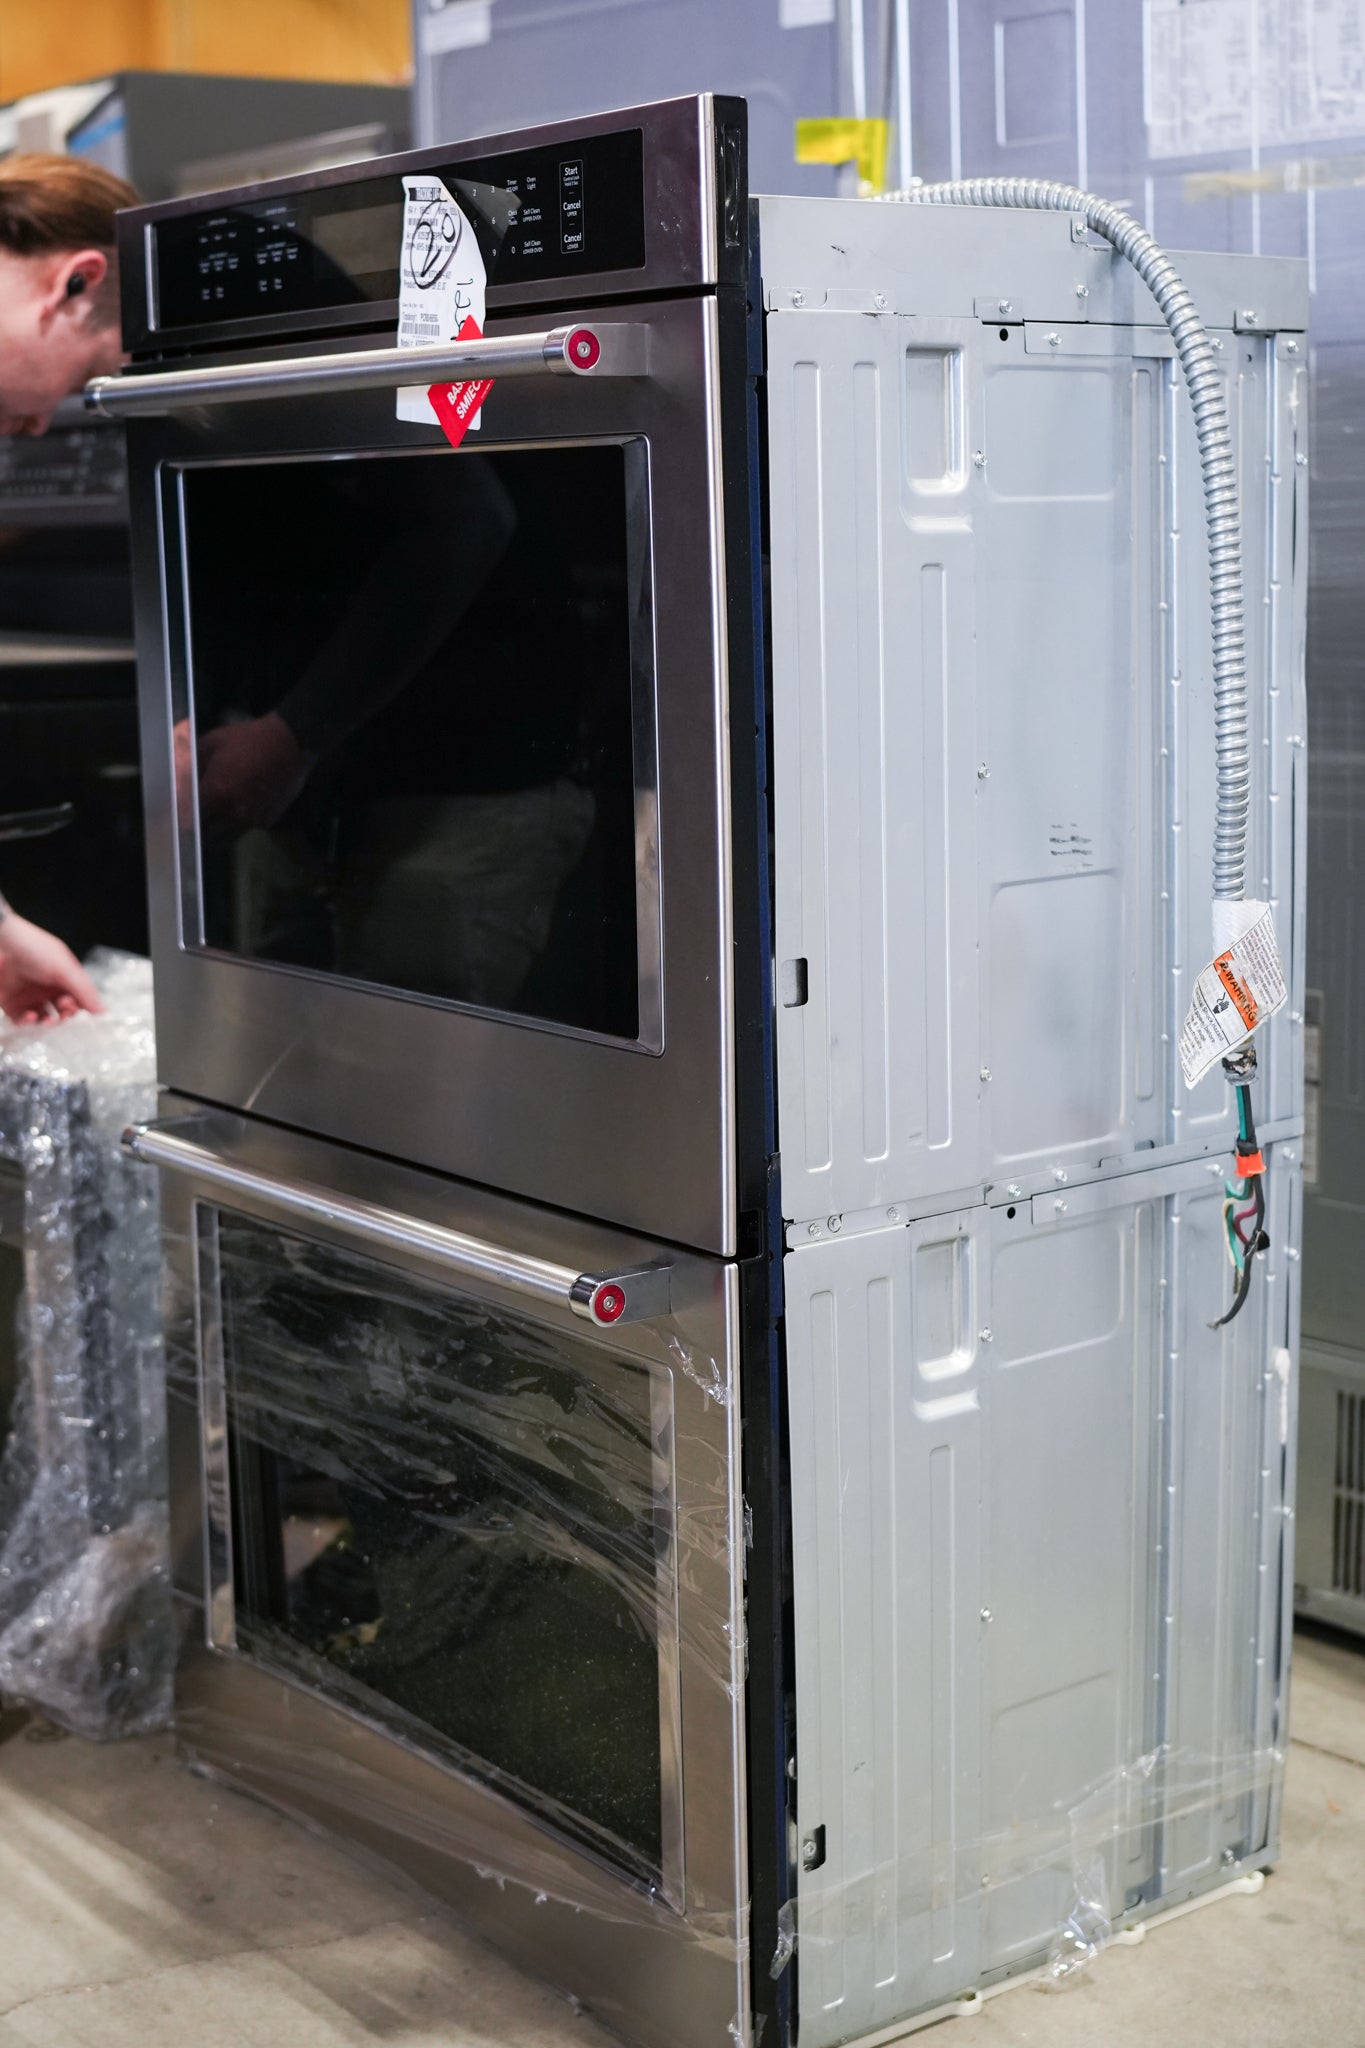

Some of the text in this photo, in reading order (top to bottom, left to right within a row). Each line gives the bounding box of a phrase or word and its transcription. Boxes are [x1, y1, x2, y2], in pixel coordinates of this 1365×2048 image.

[563, 200, 581, 211] Cancel
[563, 232, 582, 243] Cancel
[447, 381, 466, 406] BAS
[456, 380, 483, 419] SMIEC
